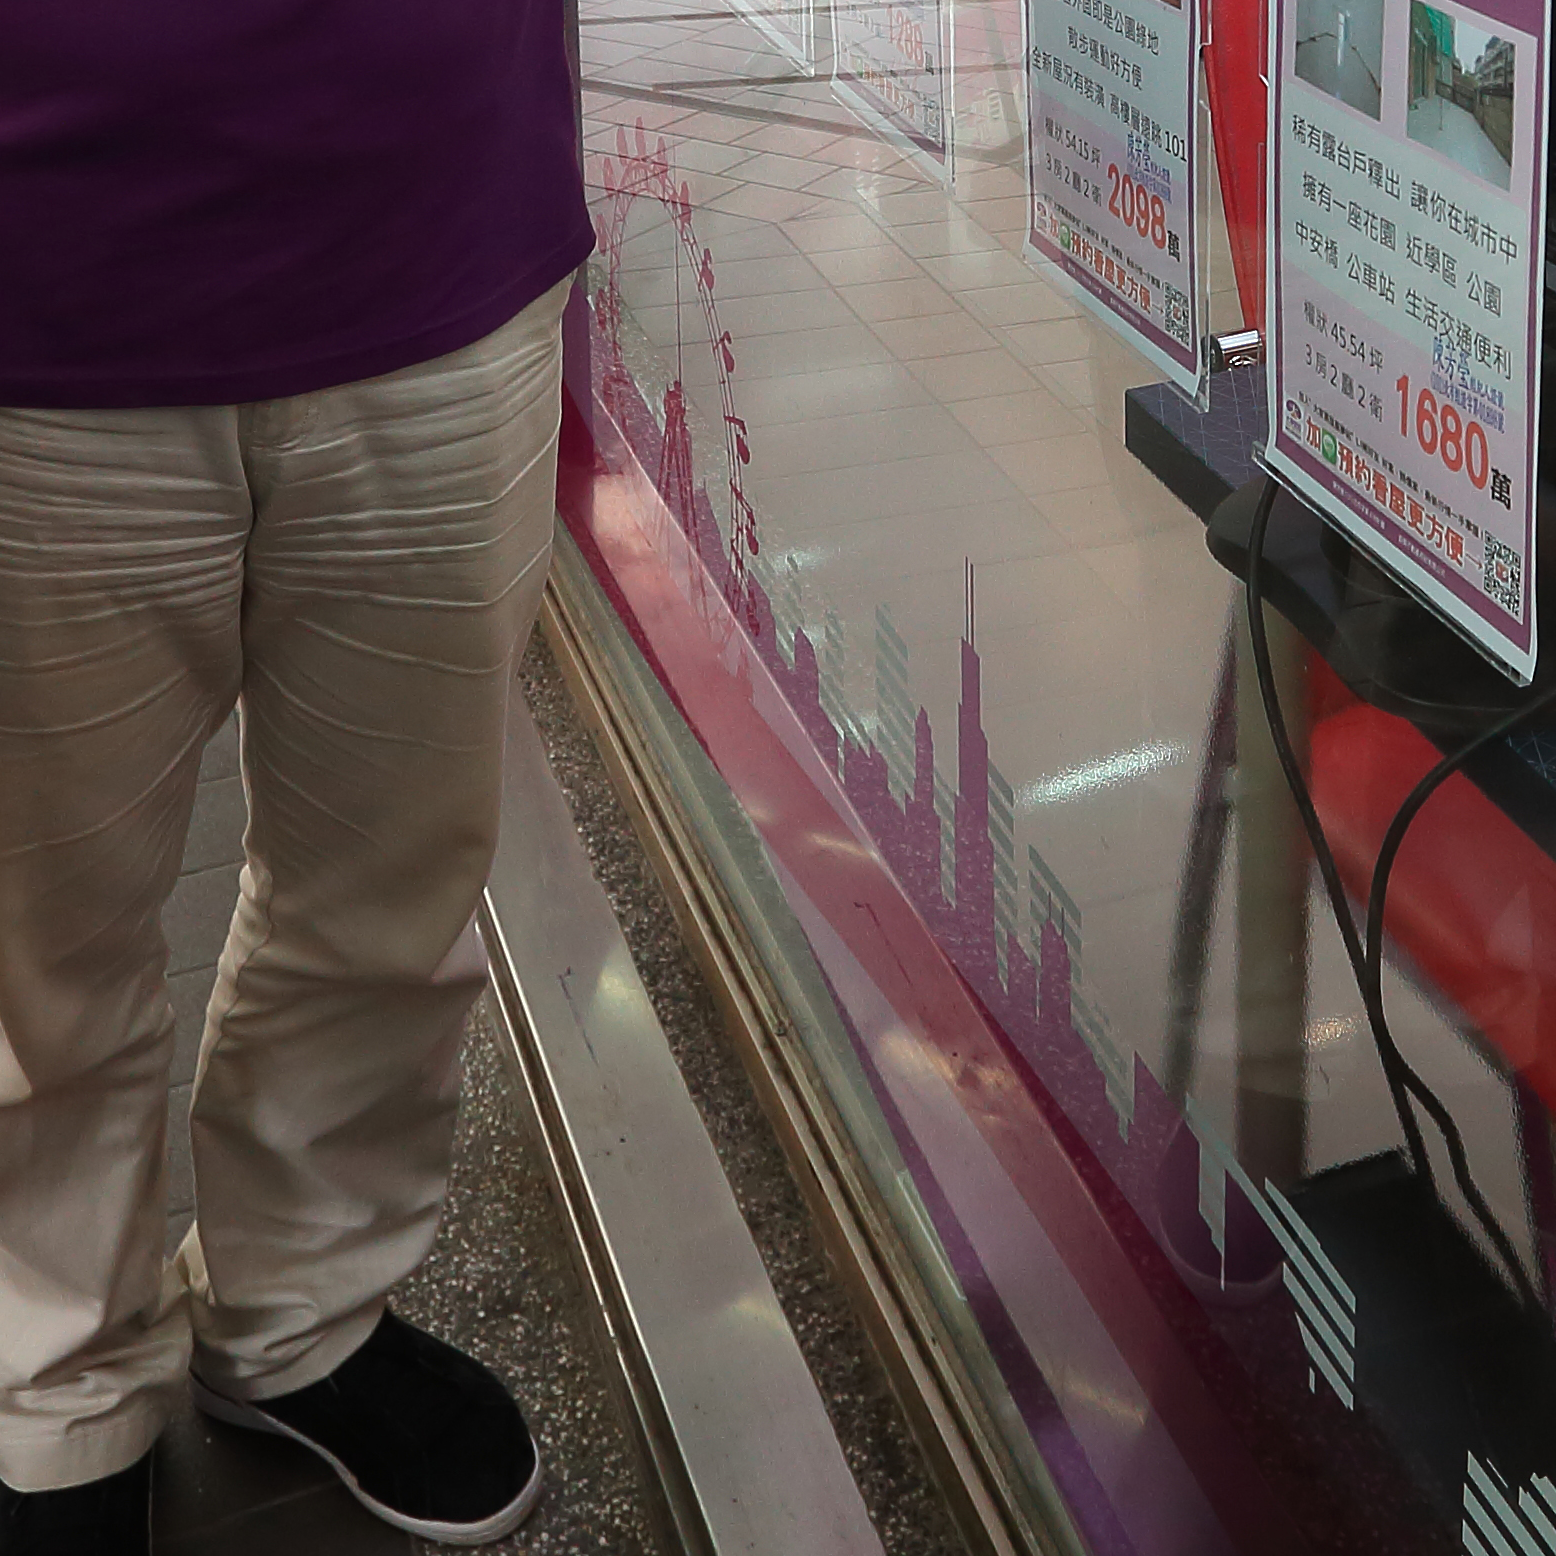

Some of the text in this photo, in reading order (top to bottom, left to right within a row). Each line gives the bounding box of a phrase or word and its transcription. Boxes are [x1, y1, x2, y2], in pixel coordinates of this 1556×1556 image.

[1106, 163, 1181, 264] 2098 萬
[1291, 113, 1518, 264] 稀有露台戶釋出 讓你在城市中
[1301, 169, 1502, 319] 擁有一座花園 近學區 公園
[1294, 218, 1513, 381] 中安橋 公車站 生活交通便利
[1395, 373, 1490, 492] 1680
[1490, 466, 1513, 512] 萬
